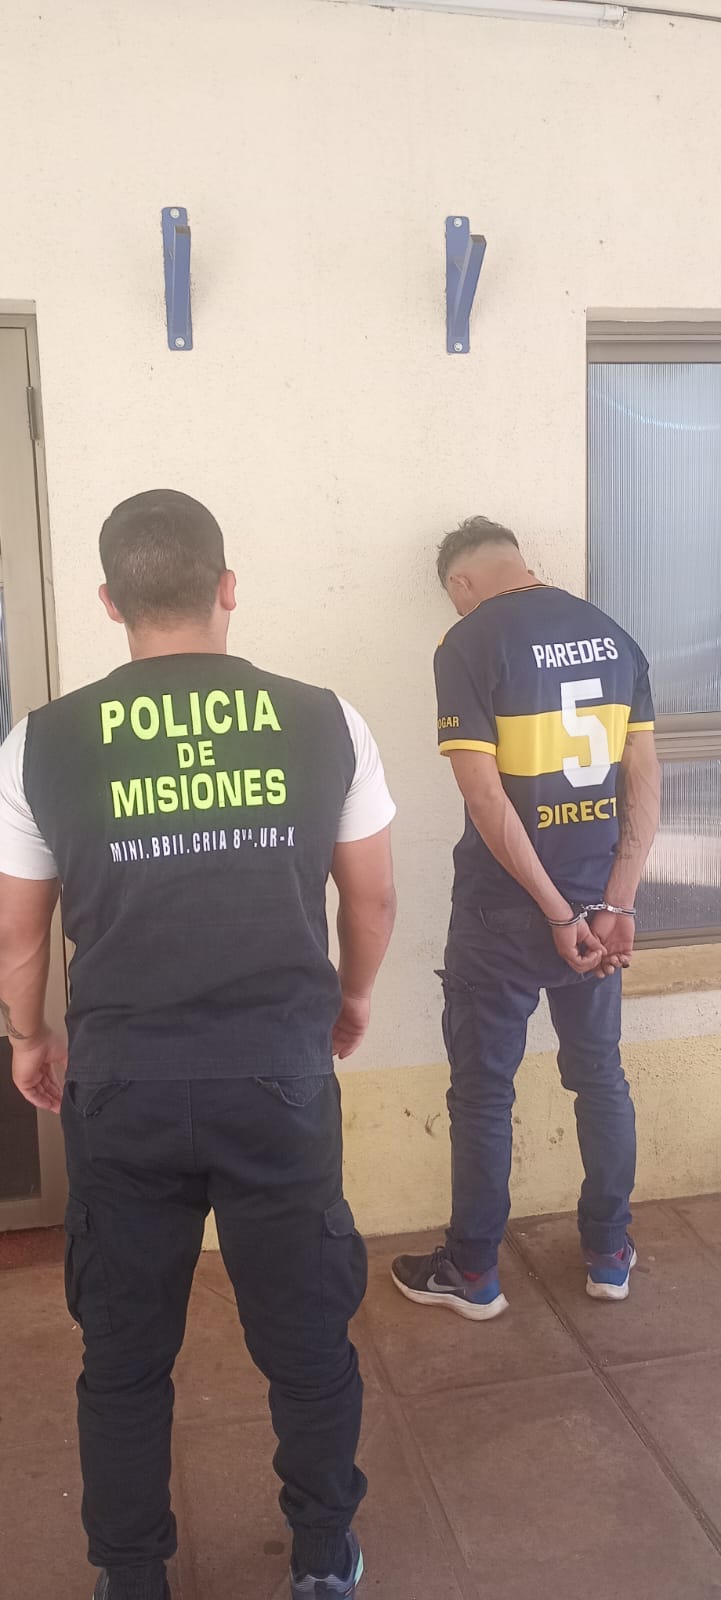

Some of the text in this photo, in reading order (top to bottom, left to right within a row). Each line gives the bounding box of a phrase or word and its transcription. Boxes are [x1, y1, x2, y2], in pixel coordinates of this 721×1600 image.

[532, 636, 619, 668] PAREDES
[100, 690, 282, 744] POLICIA
[560, 677, 611, 788] 5
[177, 740, 216, 769] DE
[110, 768, 287, 818] MISIONES
